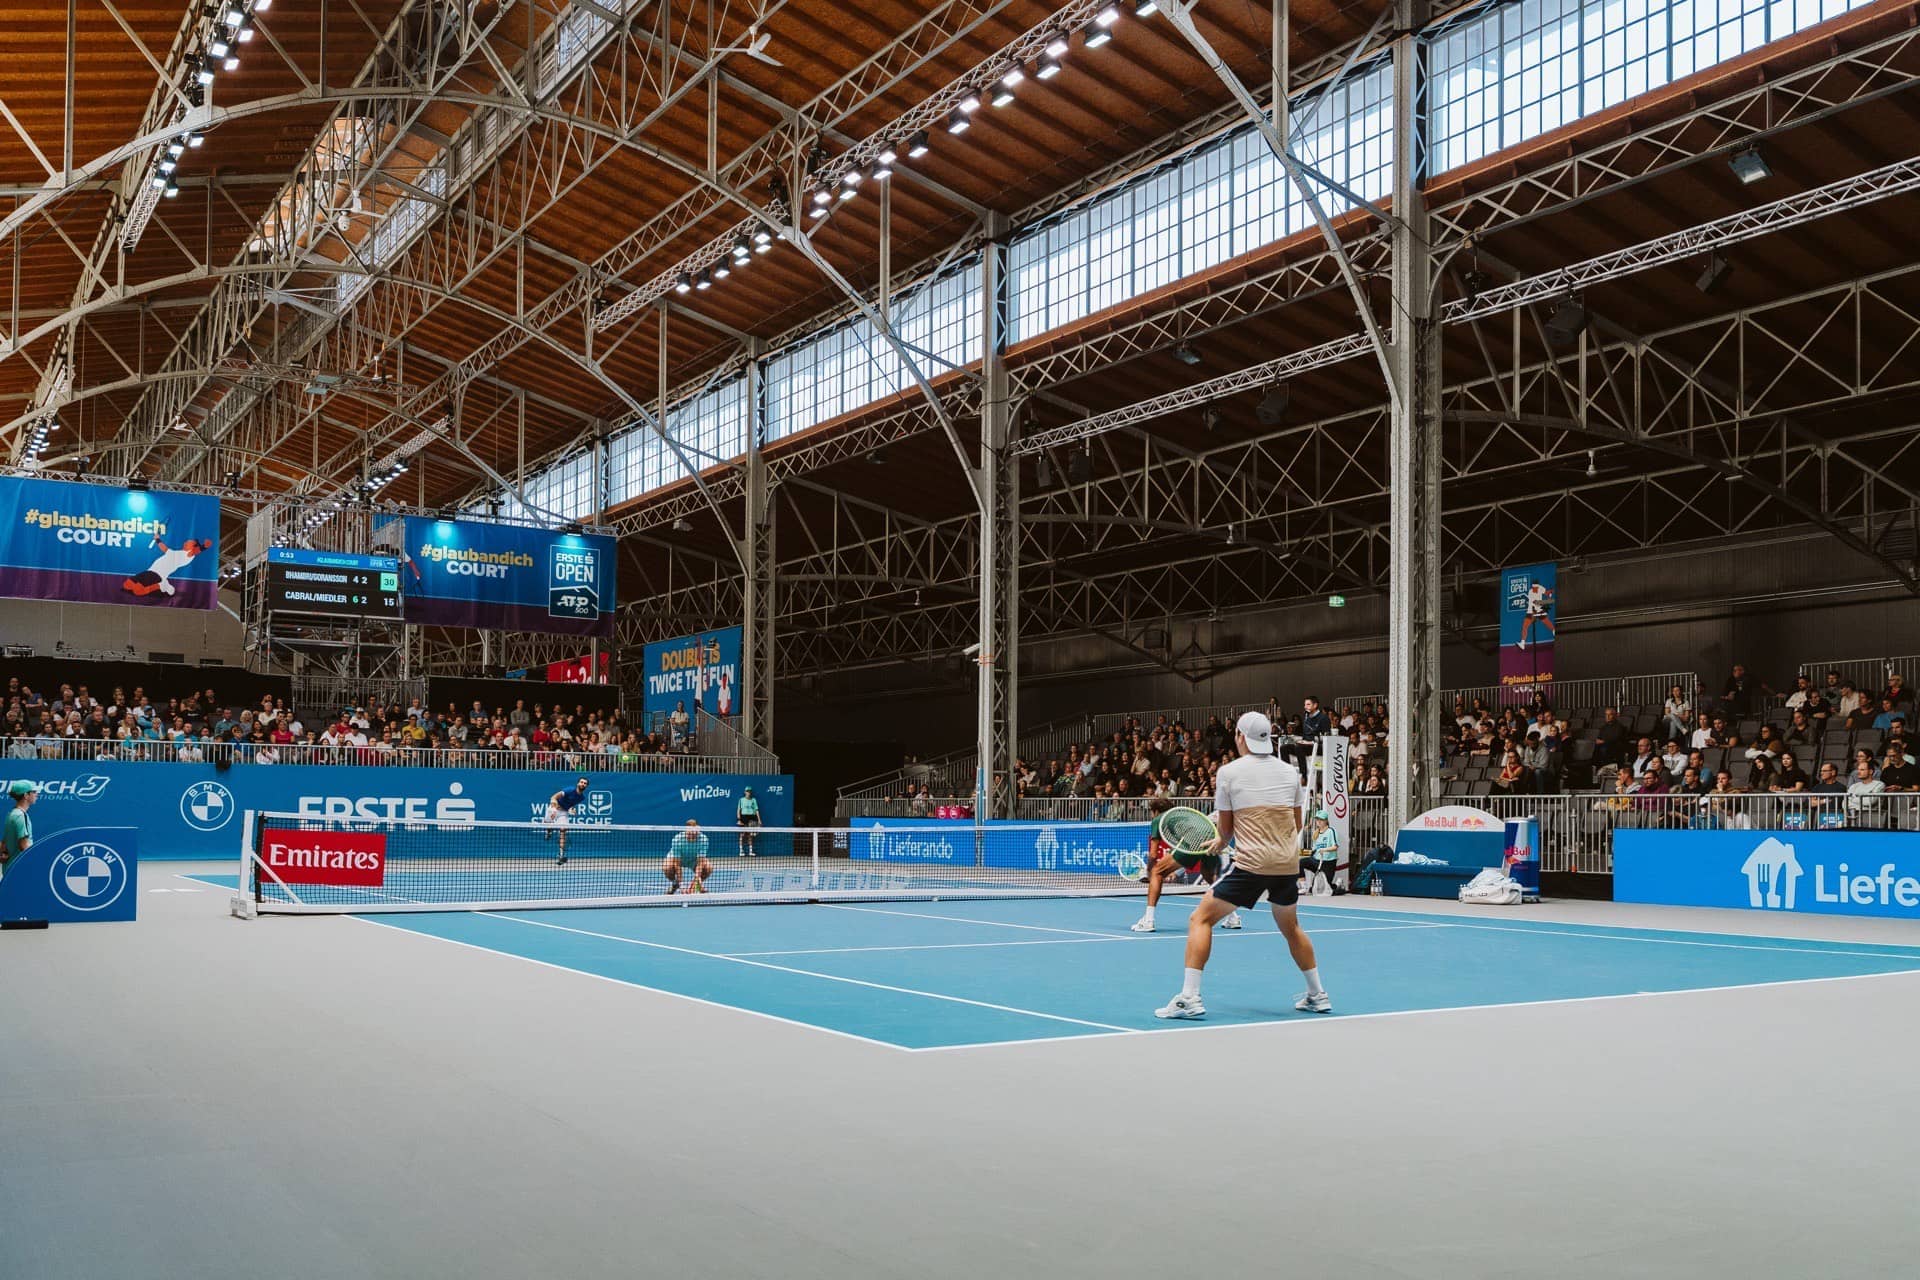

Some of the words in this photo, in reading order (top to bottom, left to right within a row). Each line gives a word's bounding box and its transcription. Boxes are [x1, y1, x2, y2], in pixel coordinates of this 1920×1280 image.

[25, 508, 166, 535] #glaubandich
[57, 528, 135, 548] COURT
[421, 543, 534, 567] #glaubandich
[556, 552, 584, 564] ERSTE
[446, 561, 509, 579] COURT
[555, 563, 594, 583] OPEN
[384, 578, 395, 586] 30
[1510, 583, 1528, 593] OPEN
[285, 591, 348, 603] CABRAL/MIEDLER
[384, 598, 395, 607] 15
[557, 595, 588, 607] ATP
[649, 671, 683, 696] TWICE
[709, 664, 735, 688] FUN
[188, 783, 227, 798] BMW
[680, 785, 731, 802] win2day
[1325, 752, 1347, 819] Servus
[298, 796, 428, 832] ERSTE
[1424, 816, 1440, 827] Red
[1441, 816, 1458, 828] Bull
[61, 846, 117, 865] BMW
[888, 834, 953, 859] Lieferando
[1513, 845, 1530, 856] Bull
[269, 843, 379, 870] Emirates
[1815, 862, 1920, 907] Liefe
